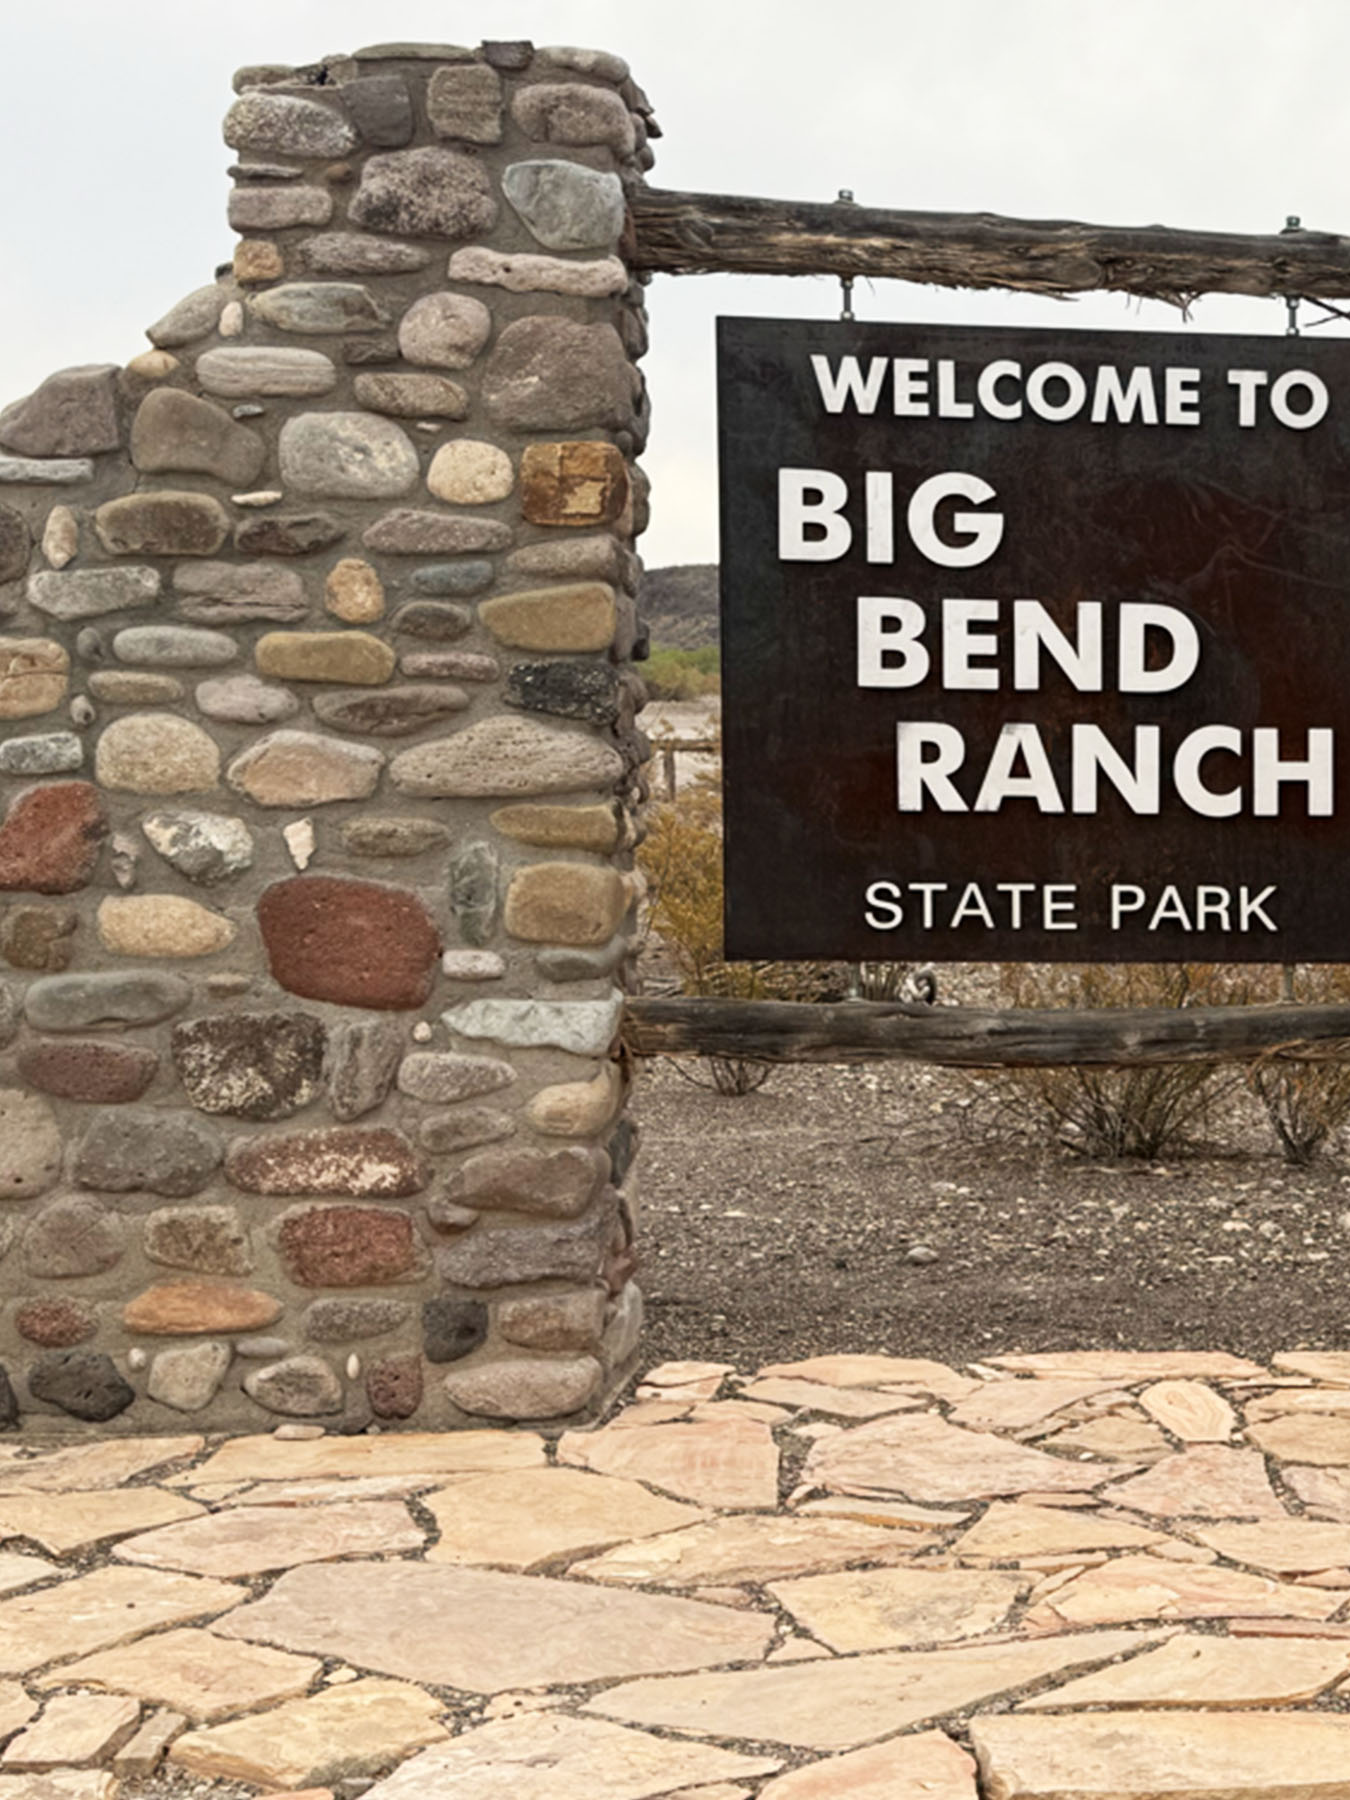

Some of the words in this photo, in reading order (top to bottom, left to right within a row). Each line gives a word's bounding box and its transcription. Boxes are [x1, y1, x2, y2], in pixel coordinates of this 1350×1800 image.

[810, 354, 1201, 426] WELCOME
[1228, 369, 1329, 429] TO
[778, 467, 1004, 567] BIG
[857, 596, 1200, 693] BEND
[896, 721, 1333, 818] RANCH
[865, 881, 1077, 930] STATE
[1111, 884, 1278, 932] PARK
